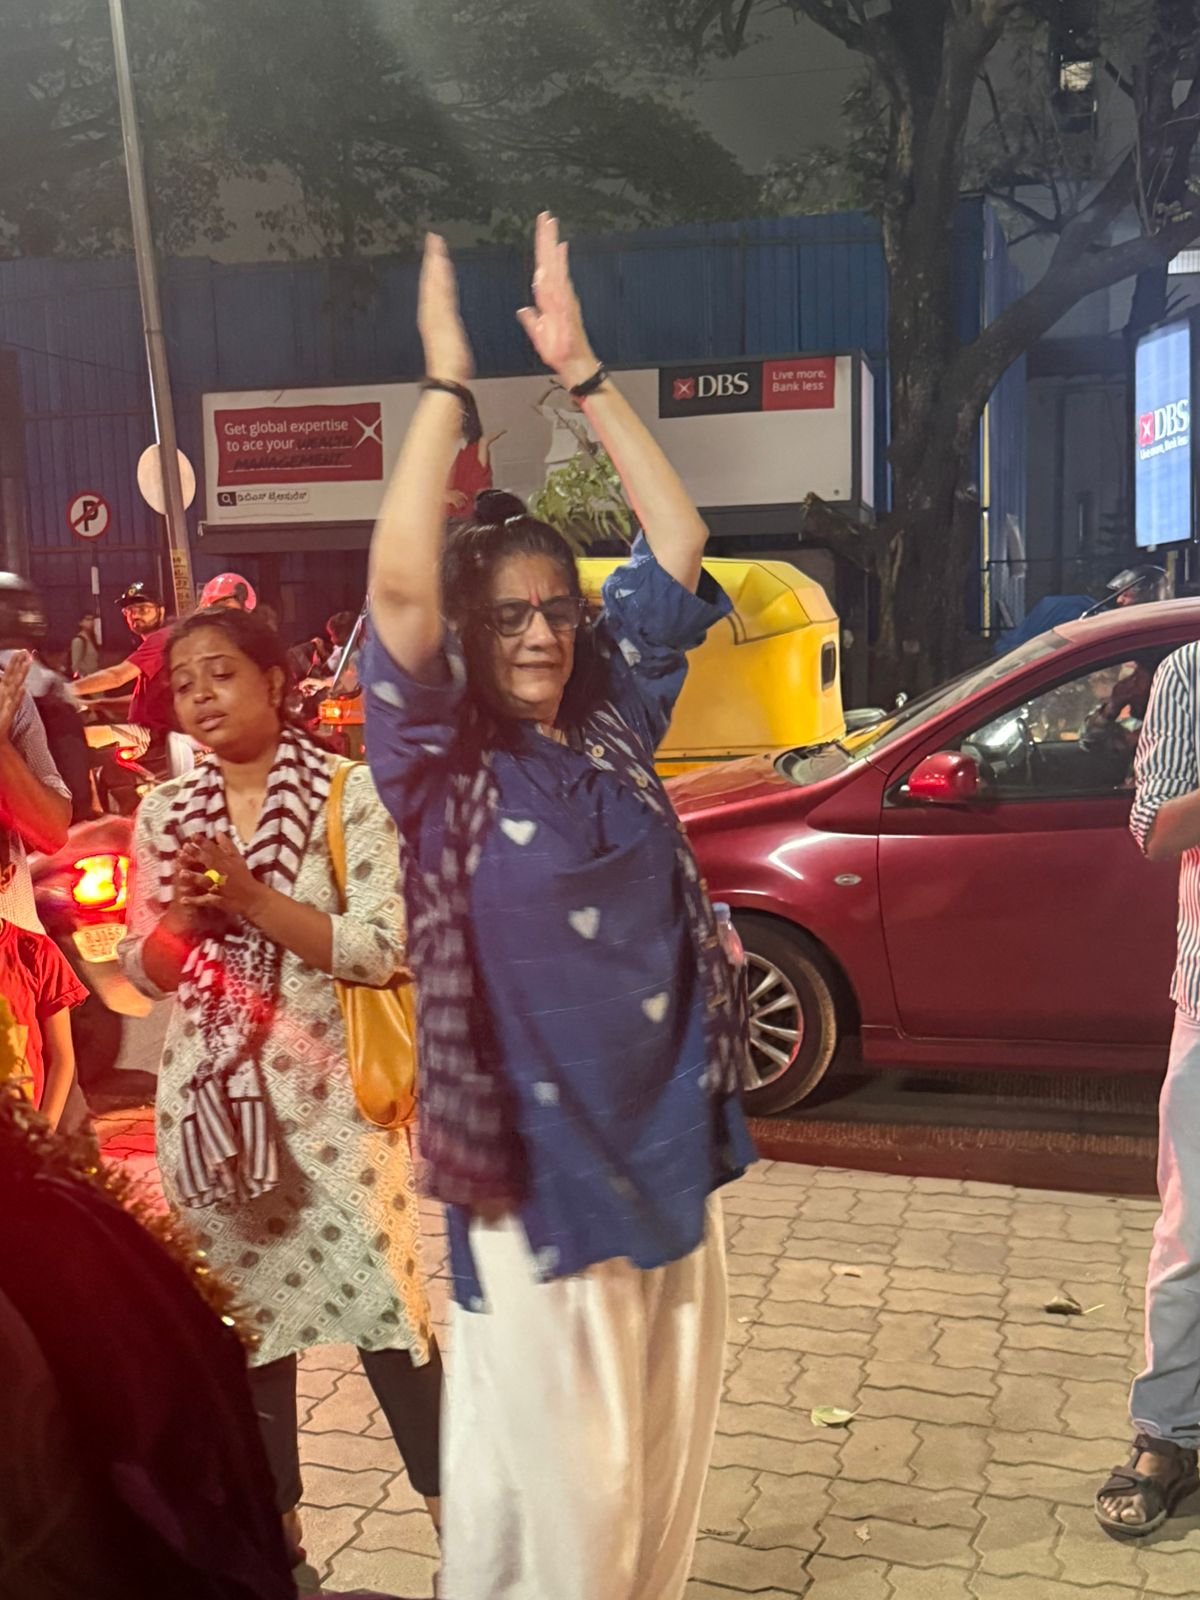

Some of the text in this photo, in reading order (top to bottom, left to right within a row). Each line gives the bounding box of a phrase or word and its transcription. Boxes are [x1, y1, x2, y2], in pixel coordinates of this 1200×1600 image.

[772, 370, 796, 380] Live
[697, 372, 749, 397] DBS
[772, 379, 825, 393] Bank less
[224, 419, 349, 437] Get global expertise
[1154, 399, 1189, 441] DBS
[226, 440, 240, 452] to
[242, 439, 264, 451] ace
[233, 452, 345, 470] MANAGEMENT
[82, 500, 99, 532] P
